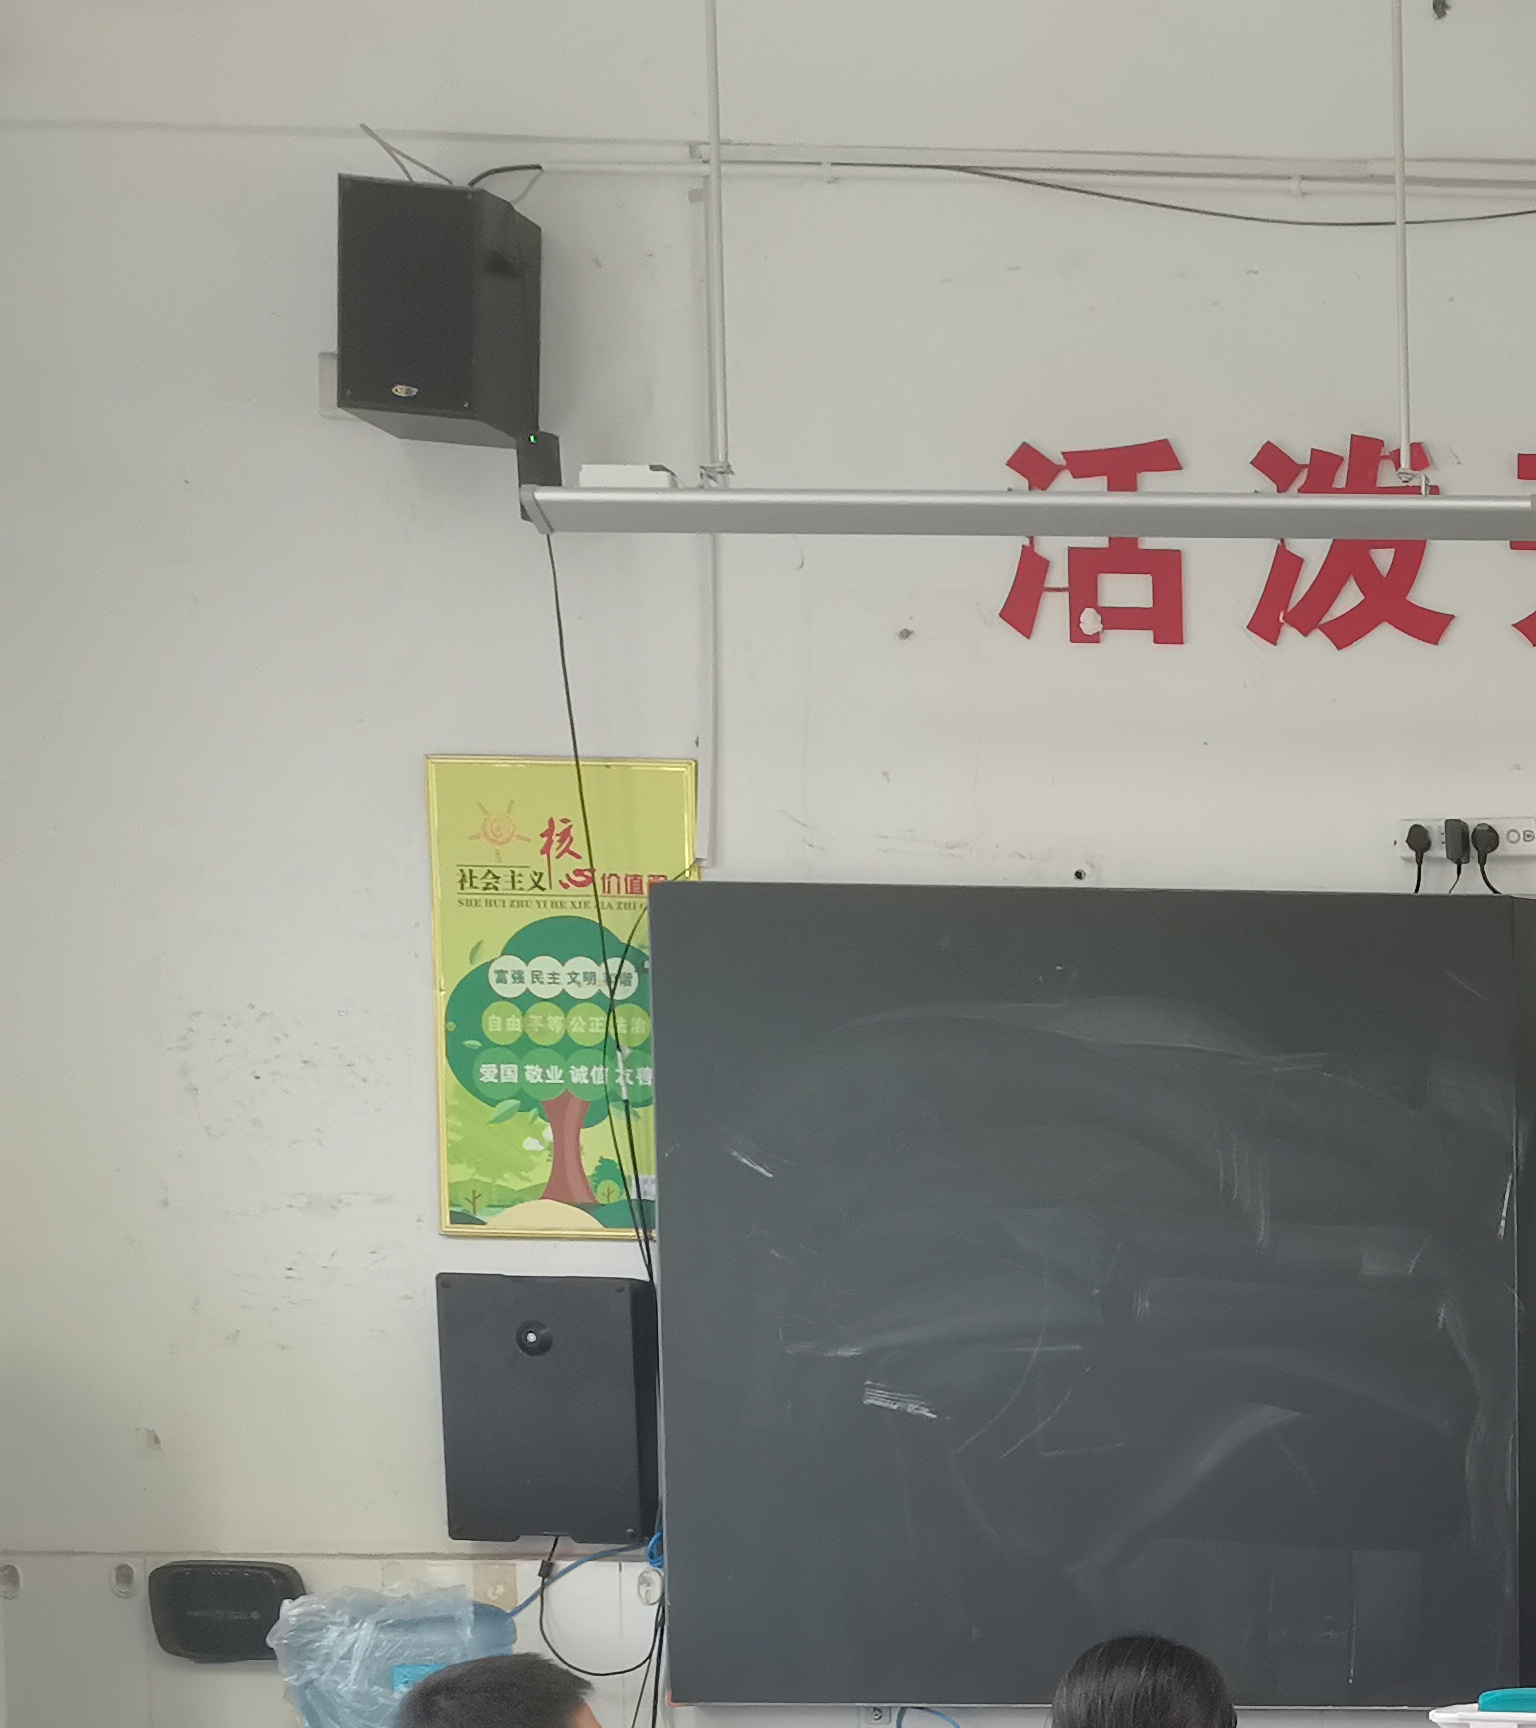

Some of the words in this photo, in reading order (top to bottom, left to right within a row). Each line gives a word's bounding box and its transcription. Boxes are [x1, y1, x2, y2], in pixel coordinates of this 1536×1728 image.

[457, 867, 547, 892] 社会主义
[457, 898, 482, 910] SHE
[485, 898, 507, 910] HUI
[508, 898, 533, 910] ZHU
[494, 969, 525, 985] 富强
[531, 970, 561, 985] 民主
[566, 971, 597, 986] 文明
[488, 1014, 523, 1032] 自由
[527, 1015, 565, 1034] 平等
[570, 1016, 606, 1034] 公正
[479, 1063, 519, 1084] 爱国
[525, 1064, 565, 1084] 敬业
[569, 1065, 609, 1086] 诚信
